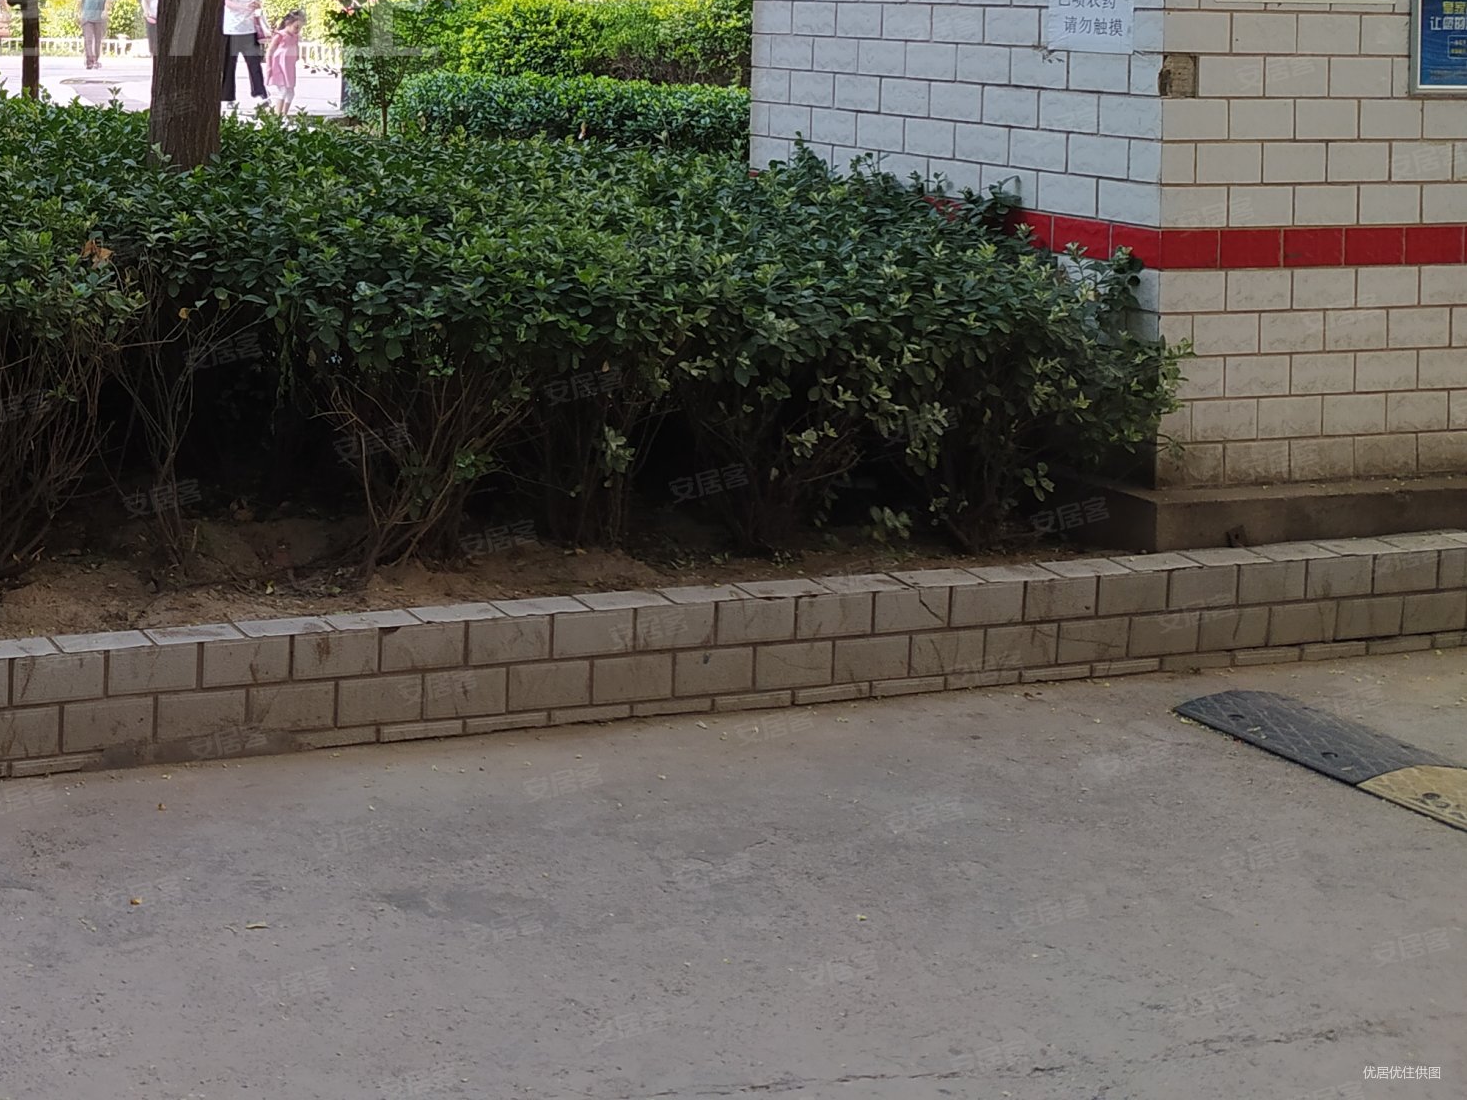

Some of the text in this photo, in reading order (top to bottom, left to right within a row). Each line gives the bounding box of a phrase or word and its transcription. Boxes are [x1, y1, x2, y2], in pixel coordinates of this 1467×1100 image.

[1064, 16, 1123, 36] 请勿触摸
[1429, 16, 1467, 31] 让您的
